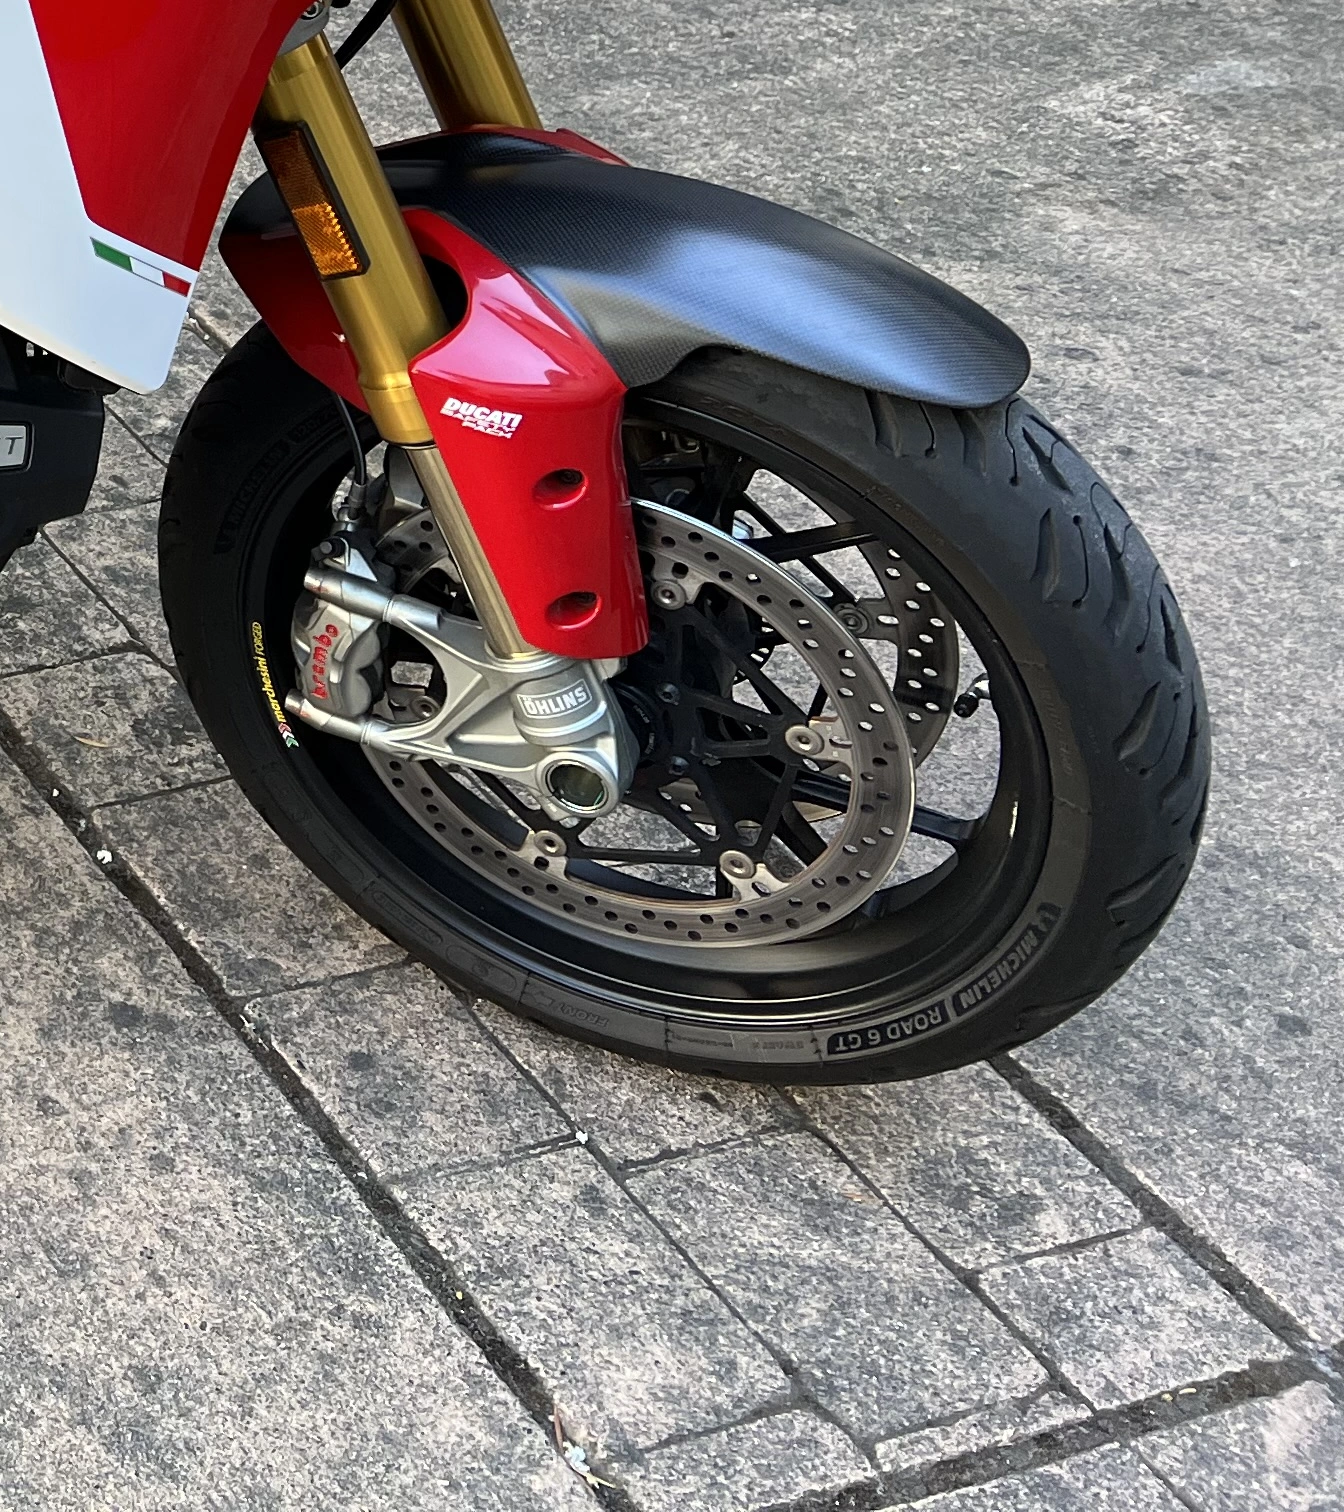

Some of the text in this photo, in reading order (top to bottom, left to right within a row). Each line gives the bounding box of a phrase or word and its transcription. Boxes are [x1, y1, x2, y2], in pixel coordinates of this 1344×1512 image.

[443, 397, 523, 428] DUCATI
[250, 620, 288, 724] marchesini FORGED
[311, 623, 339, 700] brembo
[960, 930, 1041, 1009] MICHELIN
[868, 1026, 882, 1046] 6
[886, 1005, 944, 1041] ROAD
[834, 1031, 862, 1053] GT
